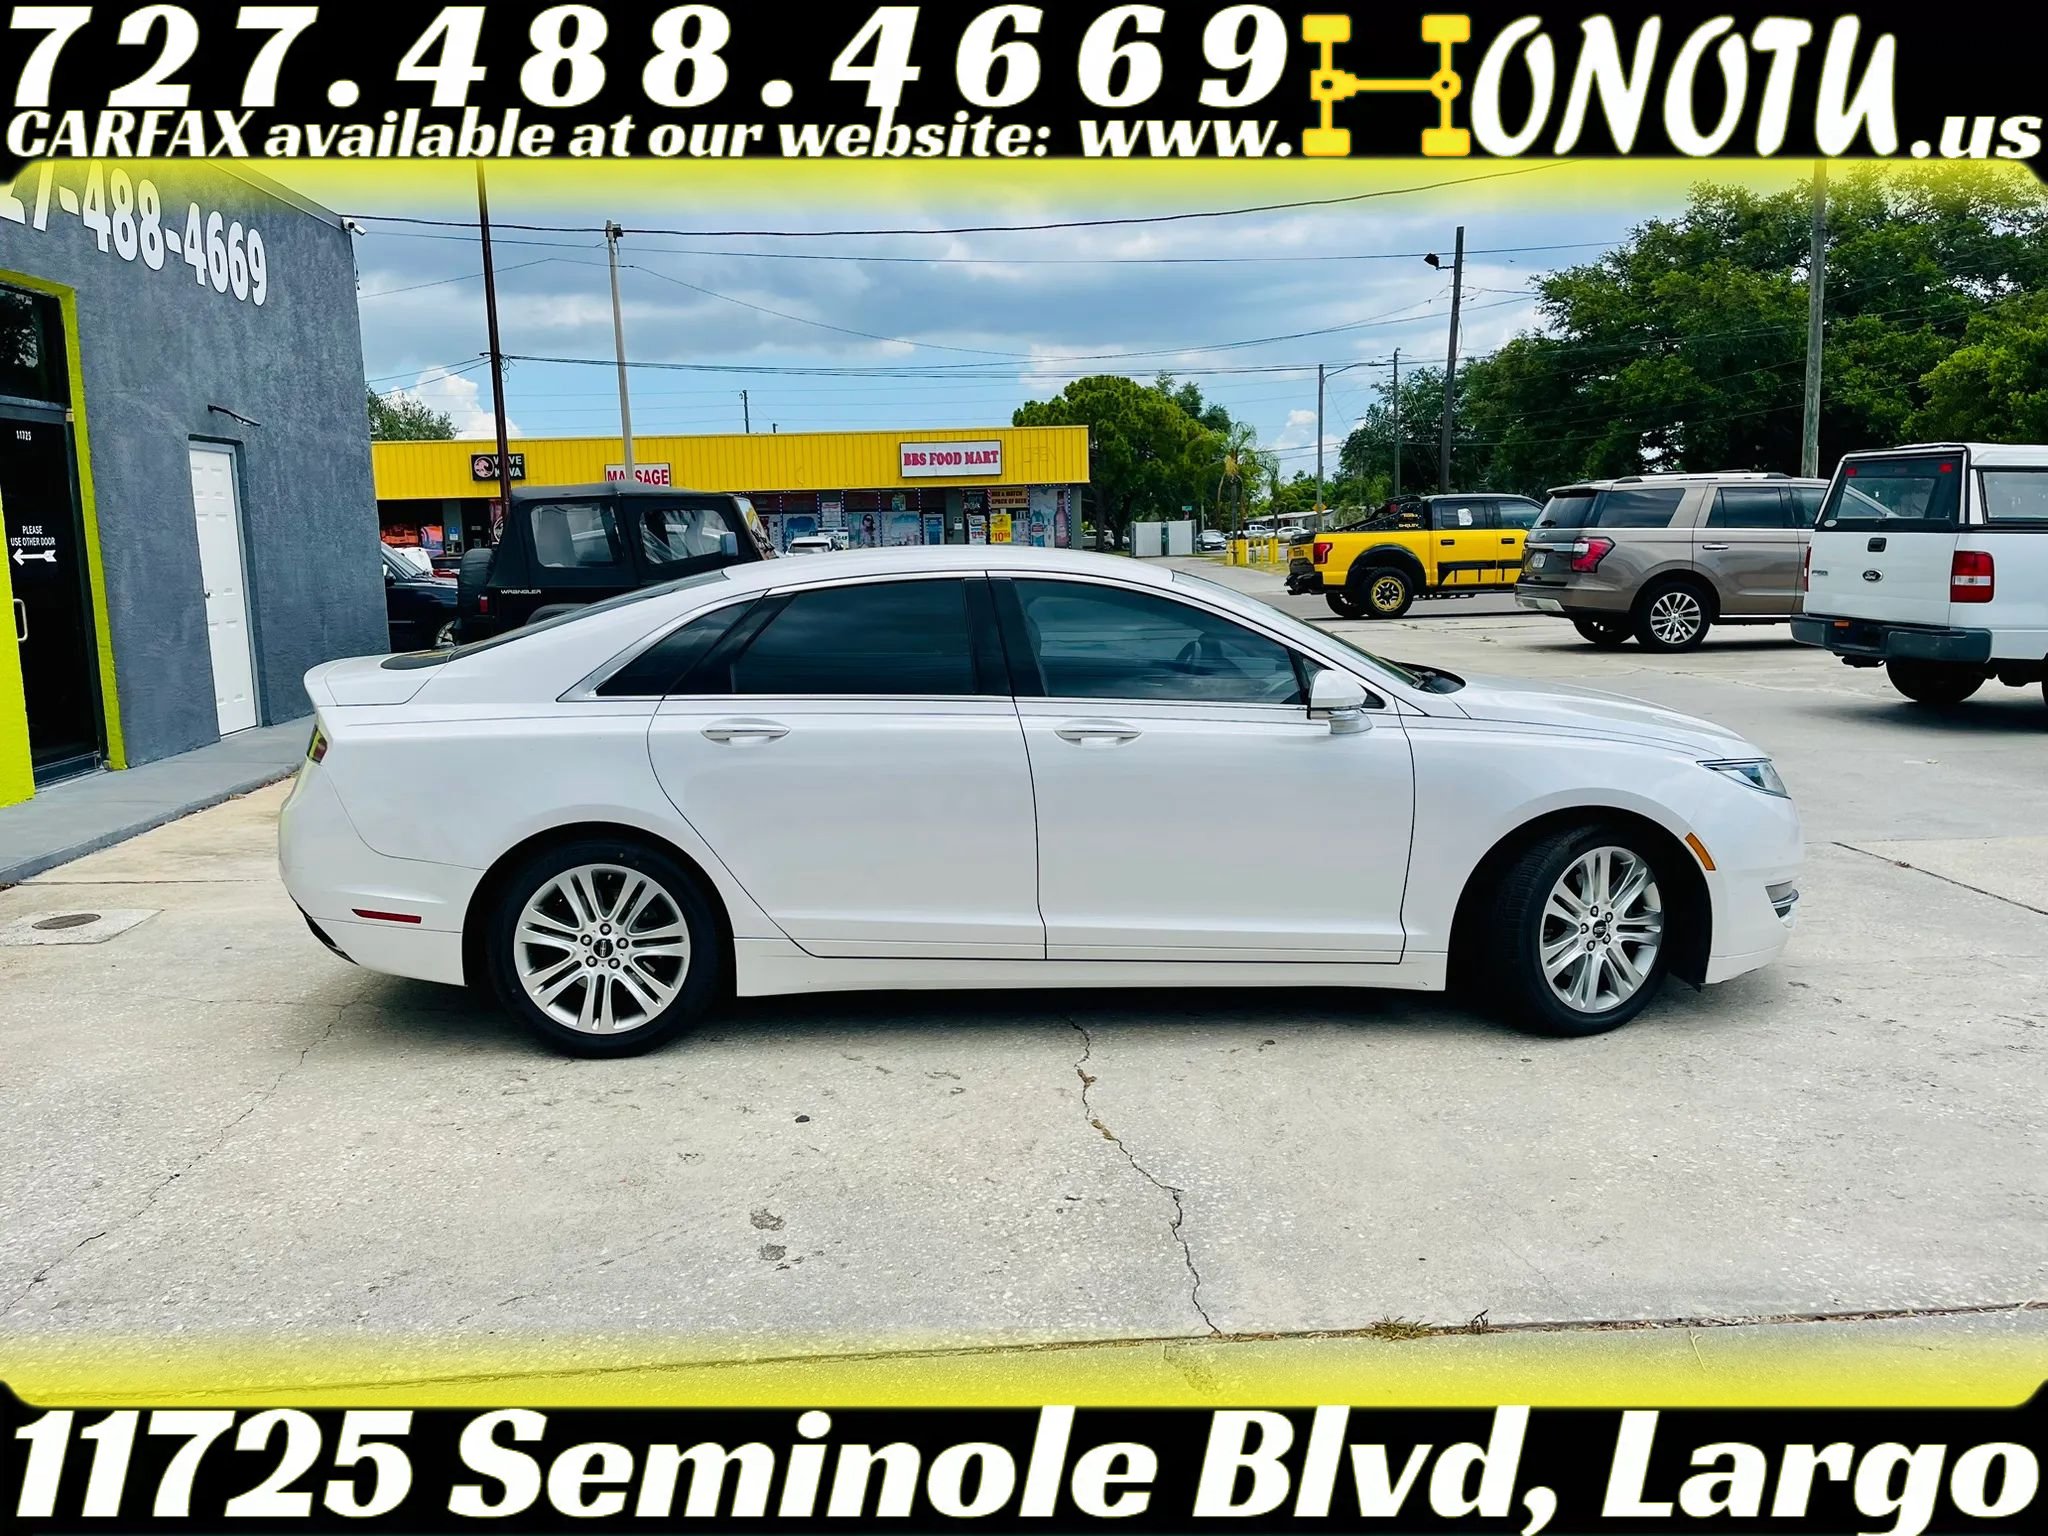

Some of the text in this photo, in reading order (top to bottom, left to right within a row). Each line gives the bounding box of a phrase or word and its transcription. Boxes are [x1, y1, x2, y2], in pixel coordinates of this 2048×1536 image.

[16, 430, 31, 440] 11725
[493, 456, 522, 465] WVE
[904, 450, 999, 466] BBS FOOD MART
[494, 467, 522, 477] KVA
[607, 469, 669, 485] MASAGE
[22, 525, 43, 535] PLEASE
[10, 536, 56, 547] USE OTHER DOOR
